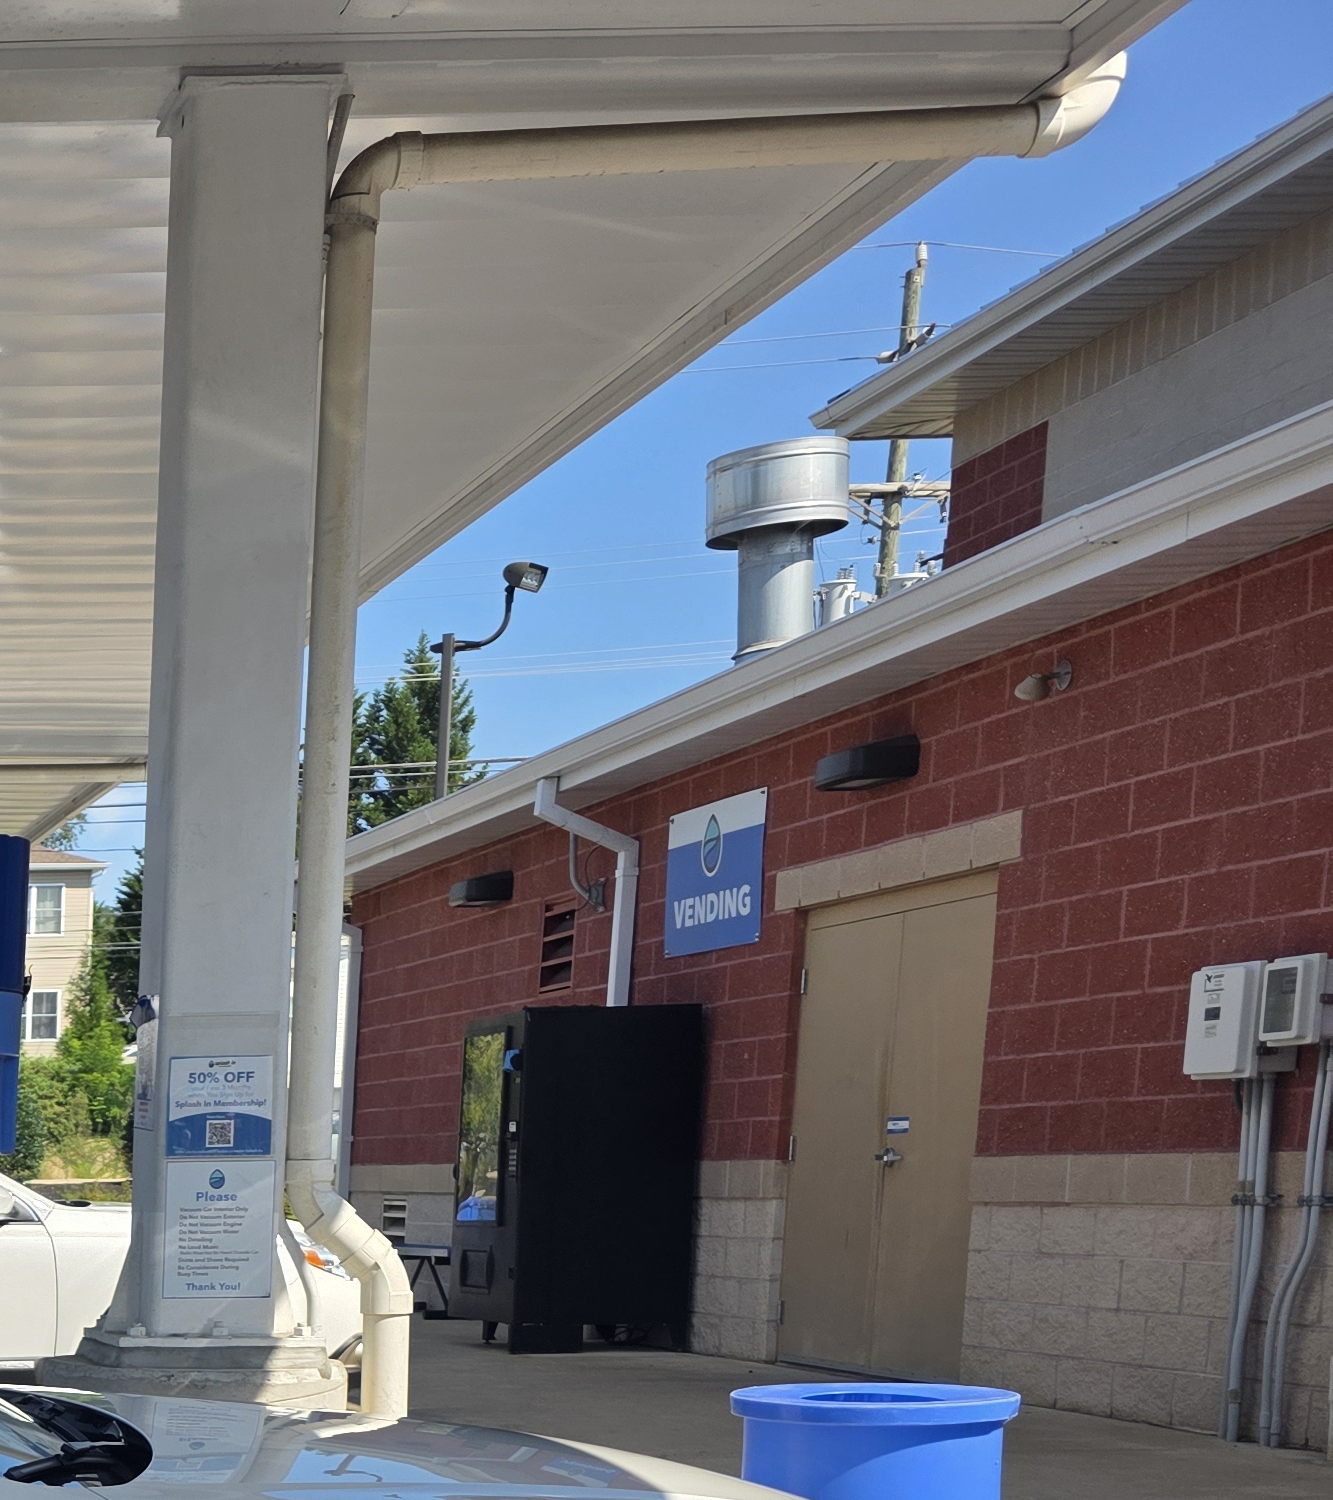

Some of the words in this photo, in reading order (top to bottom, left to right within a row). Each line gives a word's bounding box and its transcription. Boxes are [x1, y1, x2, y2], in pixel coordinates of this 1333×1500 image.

[673, 884, 752, 930] VENDING
[188, 1071, 220, 1084] 50%
[224, 1071, 256, 1083] OFF
[175, 1100, 202, 1110] Splash
[214, 1099, 267, 1108] Membership!
[196, 1191, 238, 1202] Please
[185, 1282, 216, 1291] Thank
[218, 1282, 241, 1291] You!
